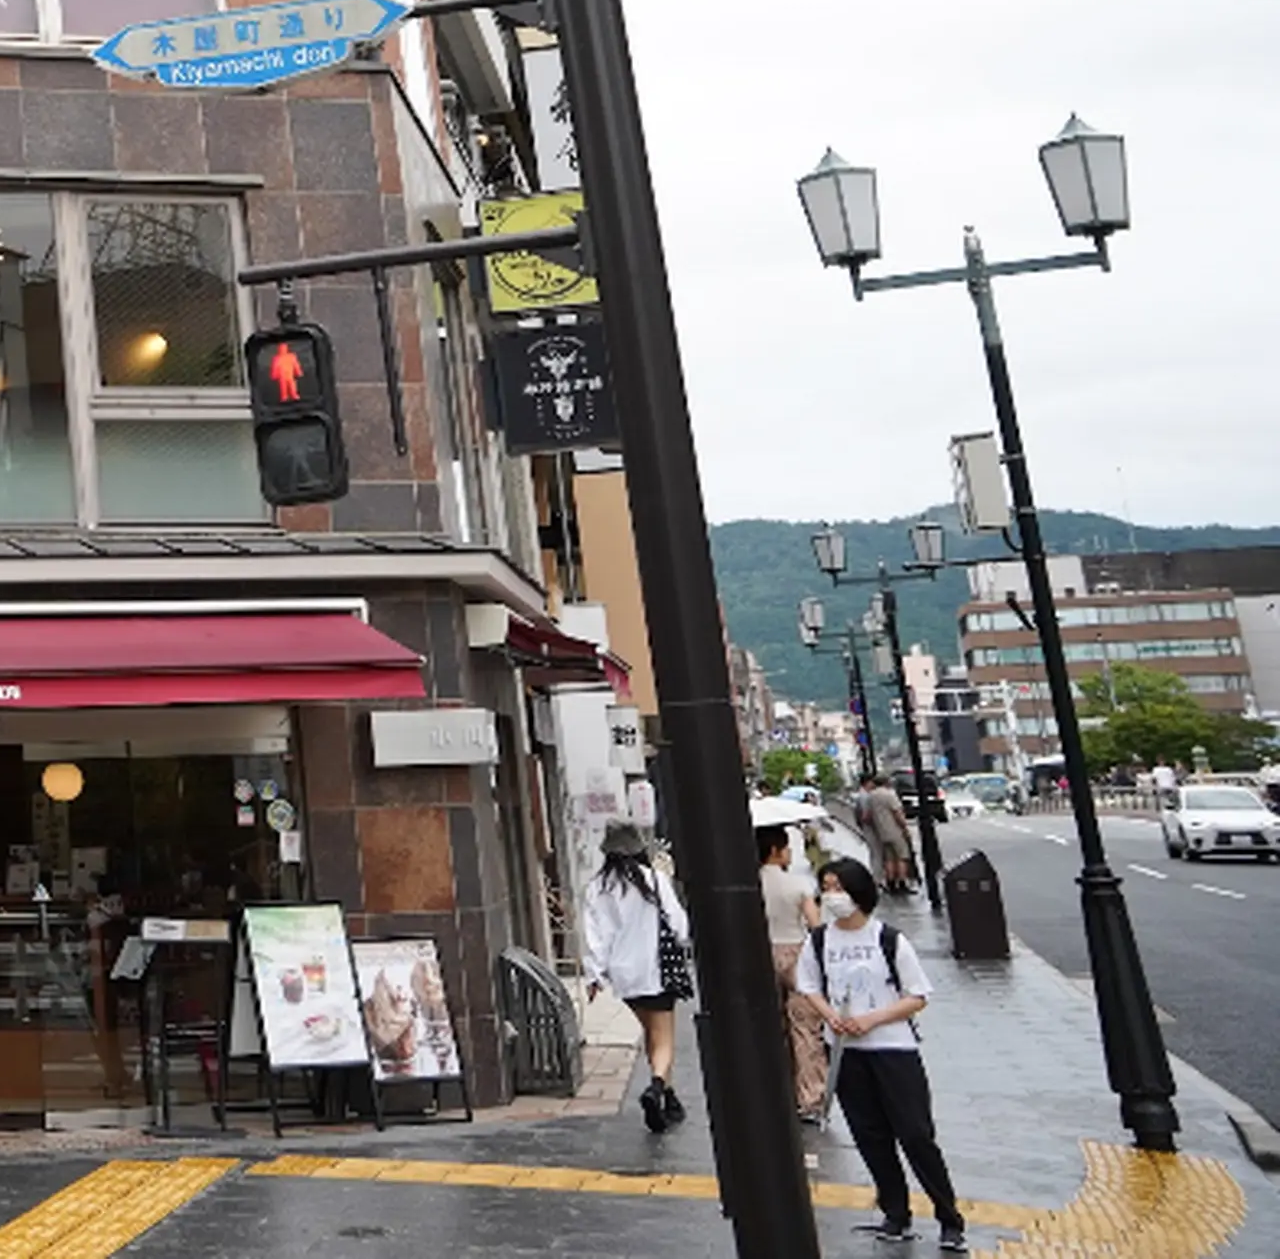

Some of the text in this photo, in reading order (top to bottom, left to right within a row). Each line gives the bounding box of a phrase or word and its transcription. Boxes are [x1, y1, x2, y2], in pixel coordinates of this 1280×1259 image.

[152, 8, 344, 56] 木屋町通り
